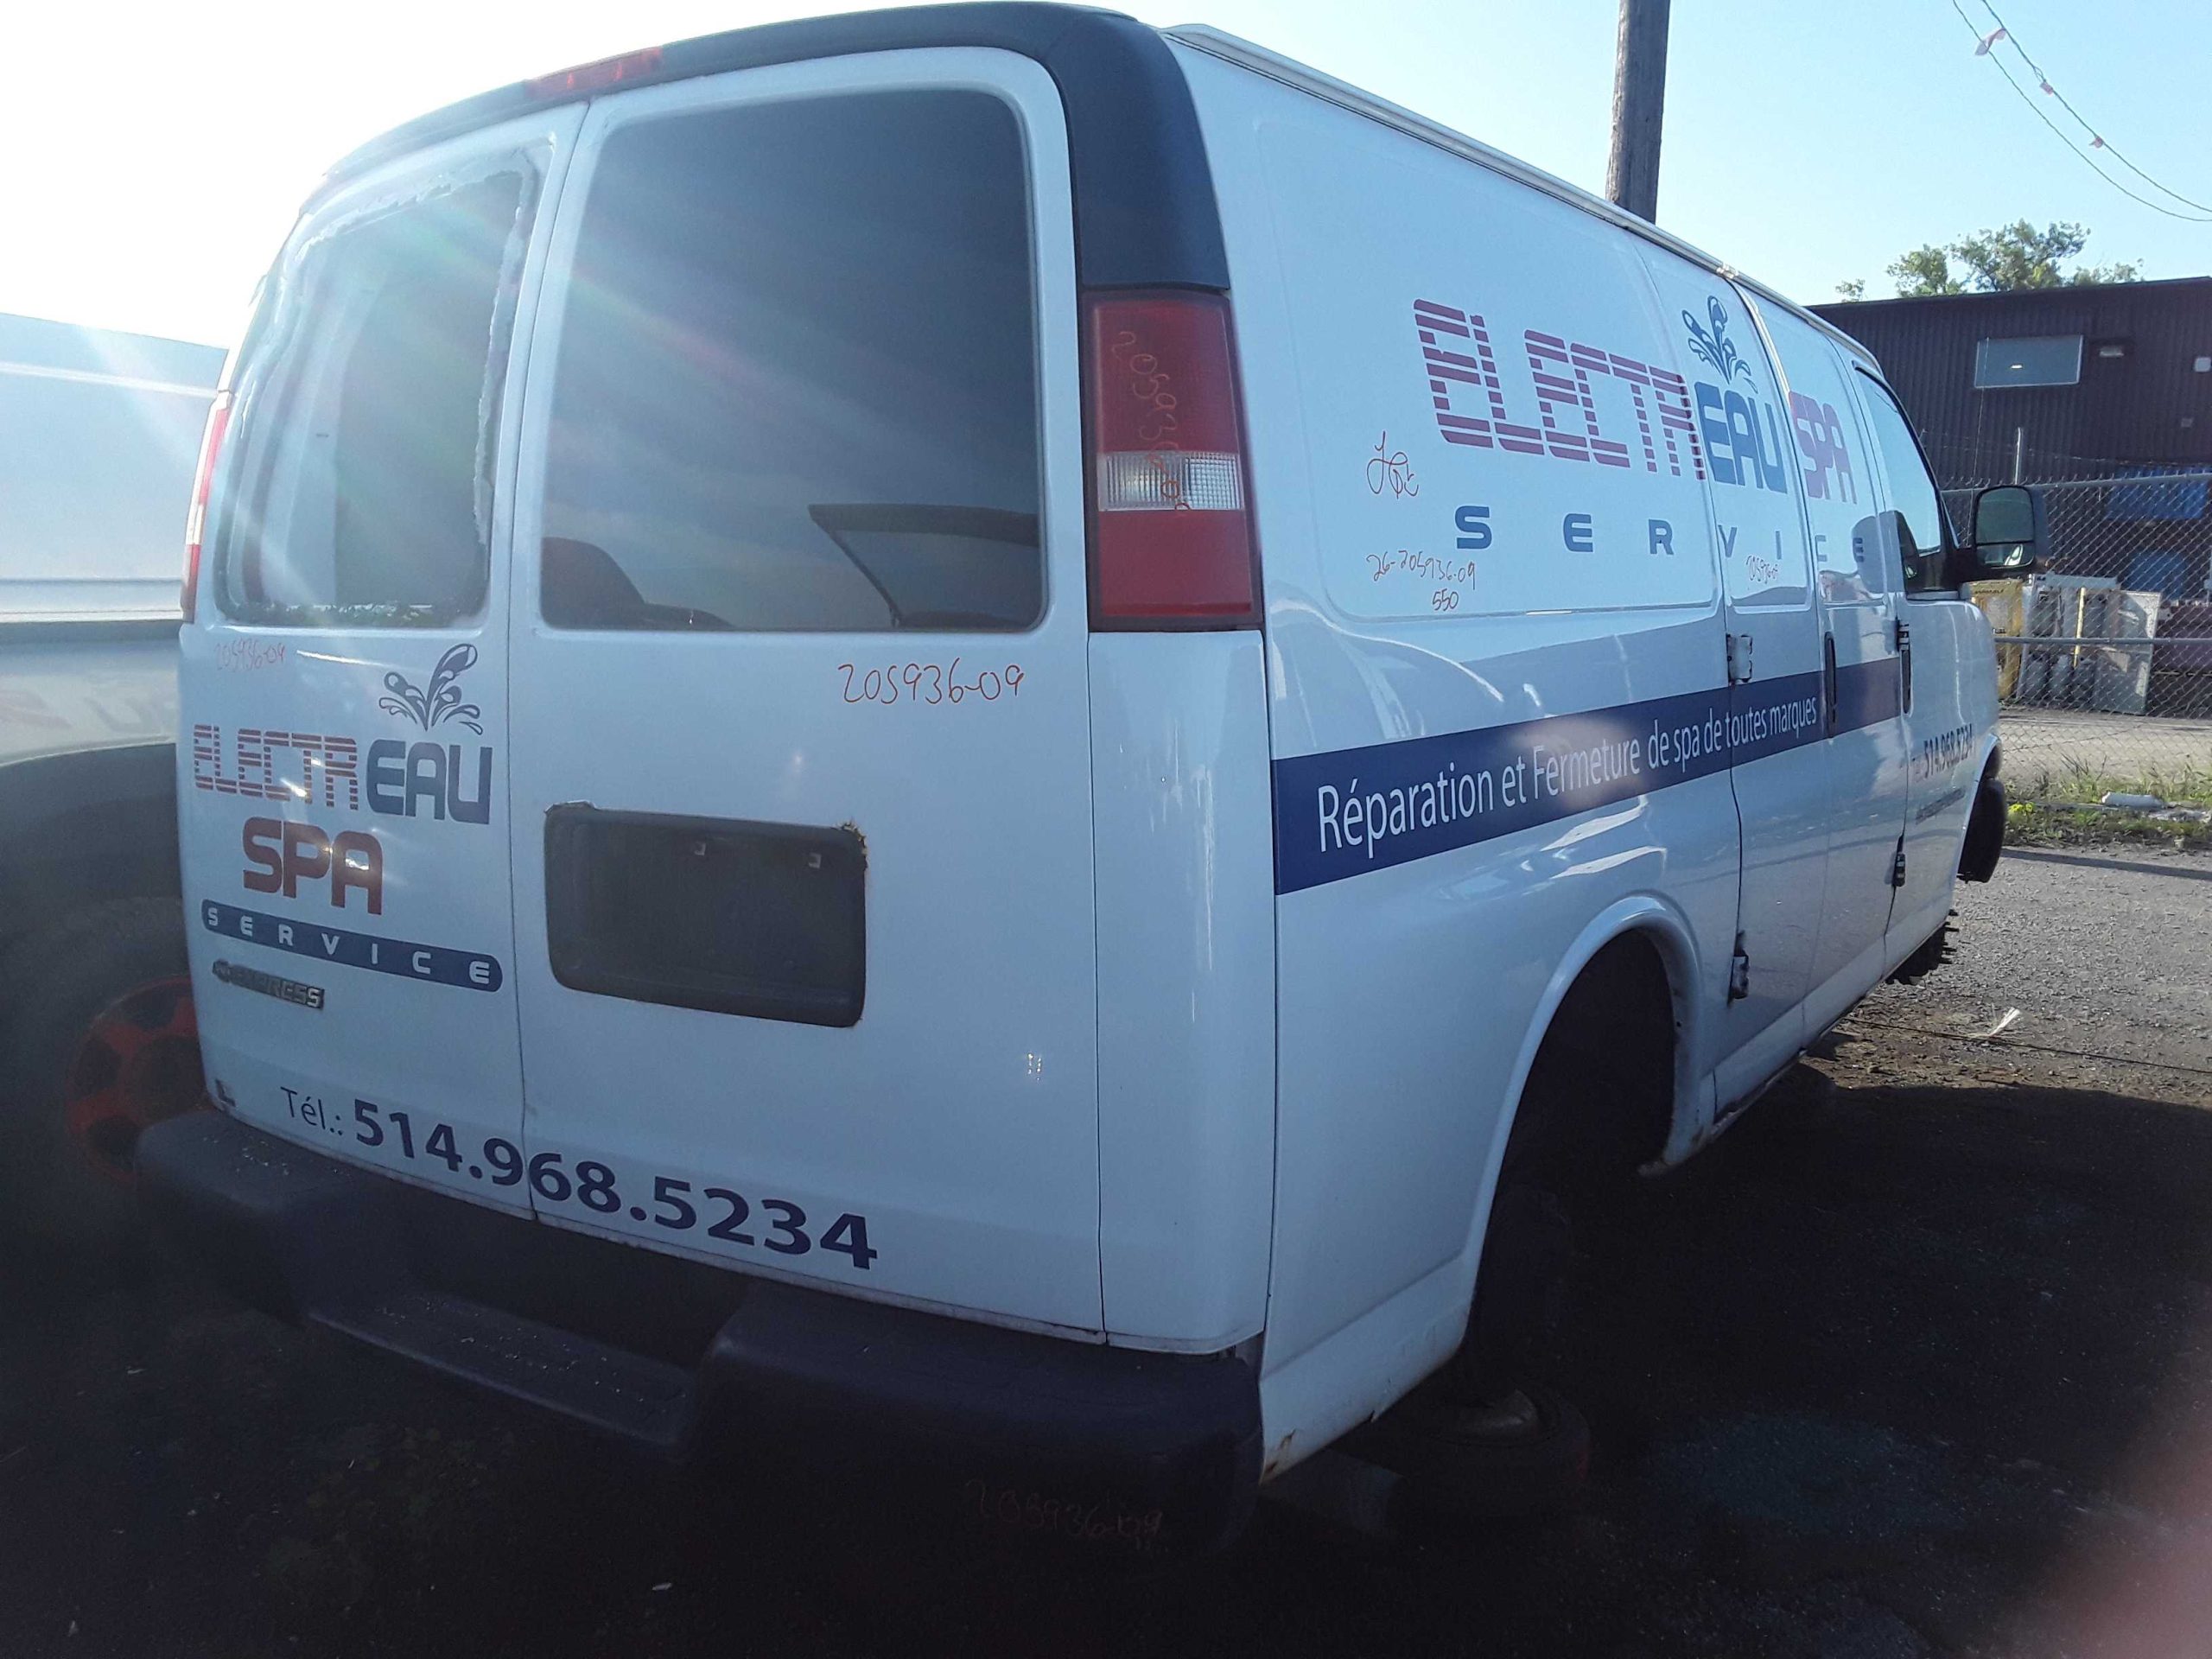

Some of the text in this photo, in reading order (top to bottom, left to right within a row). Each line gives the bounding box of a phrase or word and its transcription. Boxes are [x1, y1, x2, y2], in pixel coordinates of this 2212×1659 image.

[1789, 391, 1858, 505] SPA
[1432, 588, 1459, 611] 550
[837, 657, 1025, 704] 205936-09
[1318, 695, 1817, 859] Réparation et Fermeture de spa de toutes marques
[242, 816, 383, 915] SPA
[207, 907, 490, 985] SERVICE
[280, 1086, 878, 1270] Tél.: 514.968.5234
